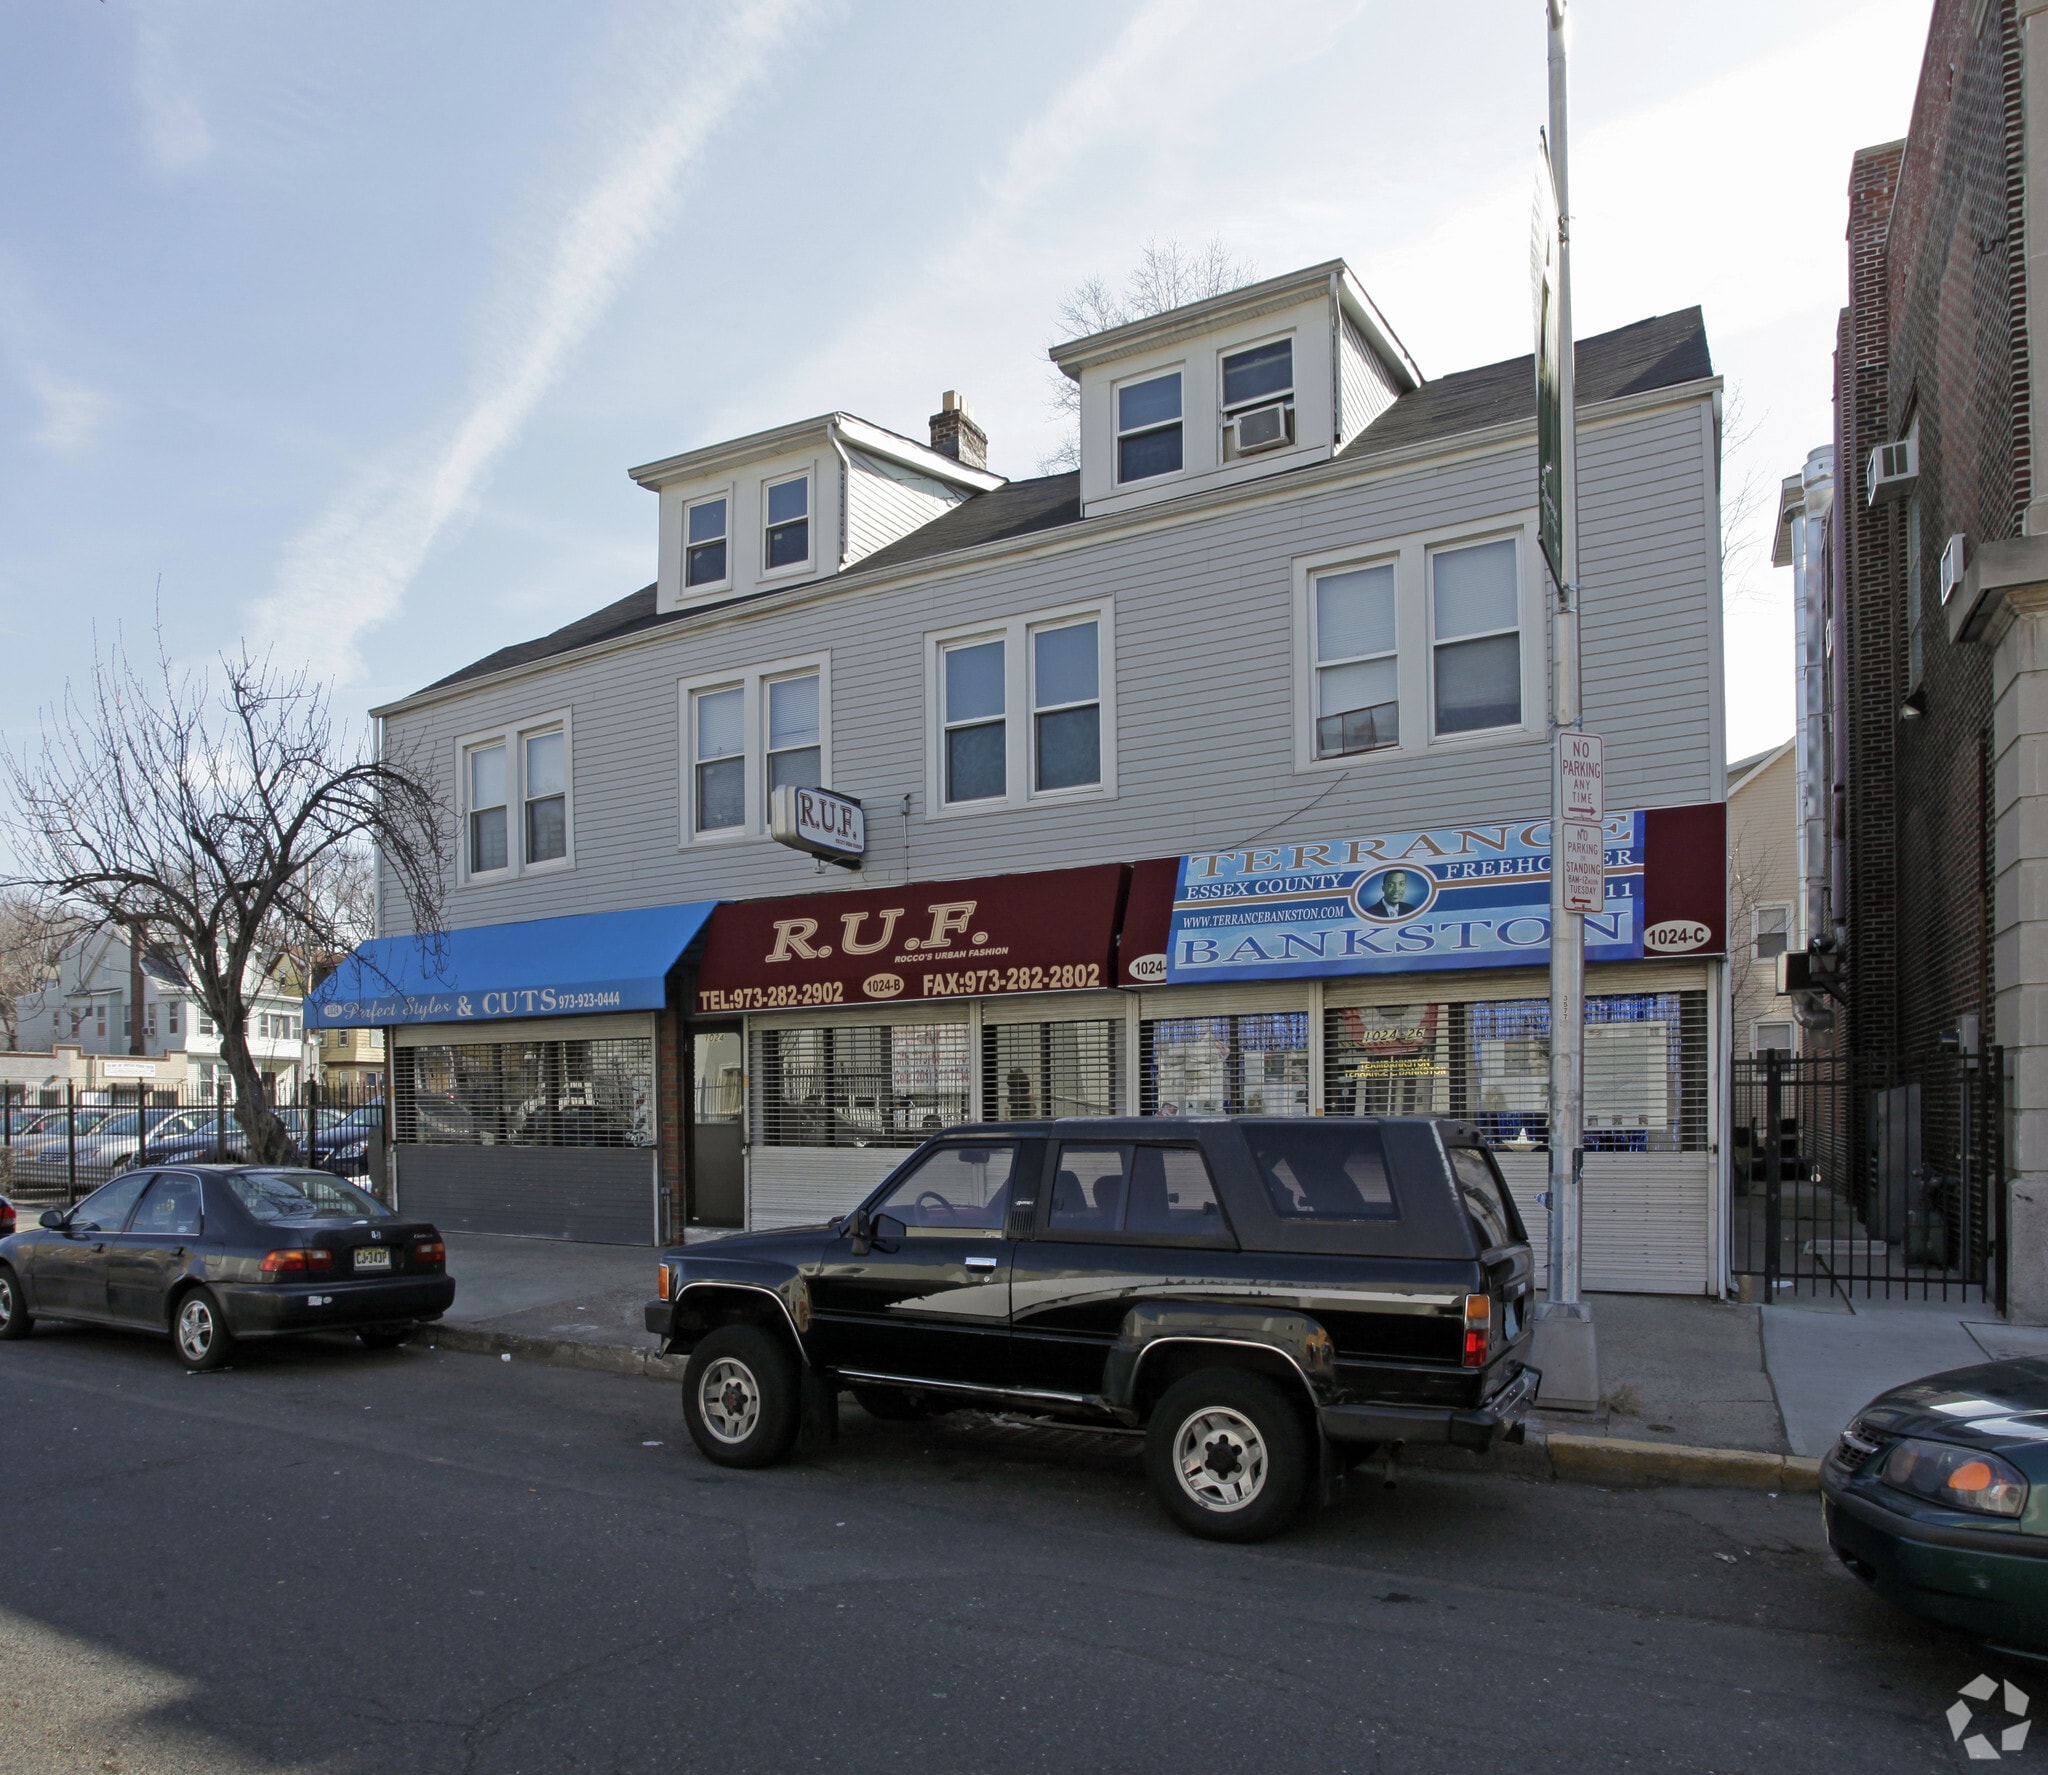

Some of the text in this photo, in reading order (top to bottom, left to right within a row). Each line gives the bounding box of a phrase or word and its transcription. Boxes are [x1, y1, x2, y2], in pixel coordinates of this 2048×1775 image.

[1573, 741, 1590, 758] NO
[1562, 760, 1601, 779] PARKING
[1573, 779, 1591, 791] ANY
[1572, 791, 1593, 804] TIME
[799, 791, 858, 840] R.U.F.
[1576, 829, 1589, 842] NO
[1567, 842, 1599, 856] PARKING
[1565, 861, 1601, 875] STANDING
[1185, 873, 1345, 900] ESSEX COUNTY
[1569, 884, 1597, 895] TUESDAY
[1183, 905, 1345, 929] WWW.TERRANCEBANKSTON.COM
[765, 900, 989, 963] R.U.F.
[1178, 911, 1631, 966] BANKSTON
[1648, 927, 1705, 945] 1024-C
[894, 946, 1009, 964] ROCCO'S URBAN FASHION
[1134, 959, 1167, 976] 1024-
[866, 978, 901, 993] 1024-B
[923, 963, 1100, 996] FAX:973-282-2802
[700, 981, 844, 1010] TEL:973-282-2902
[343, 988, 620, 1024] Perfect Styles & CUTS 973-923-0444
